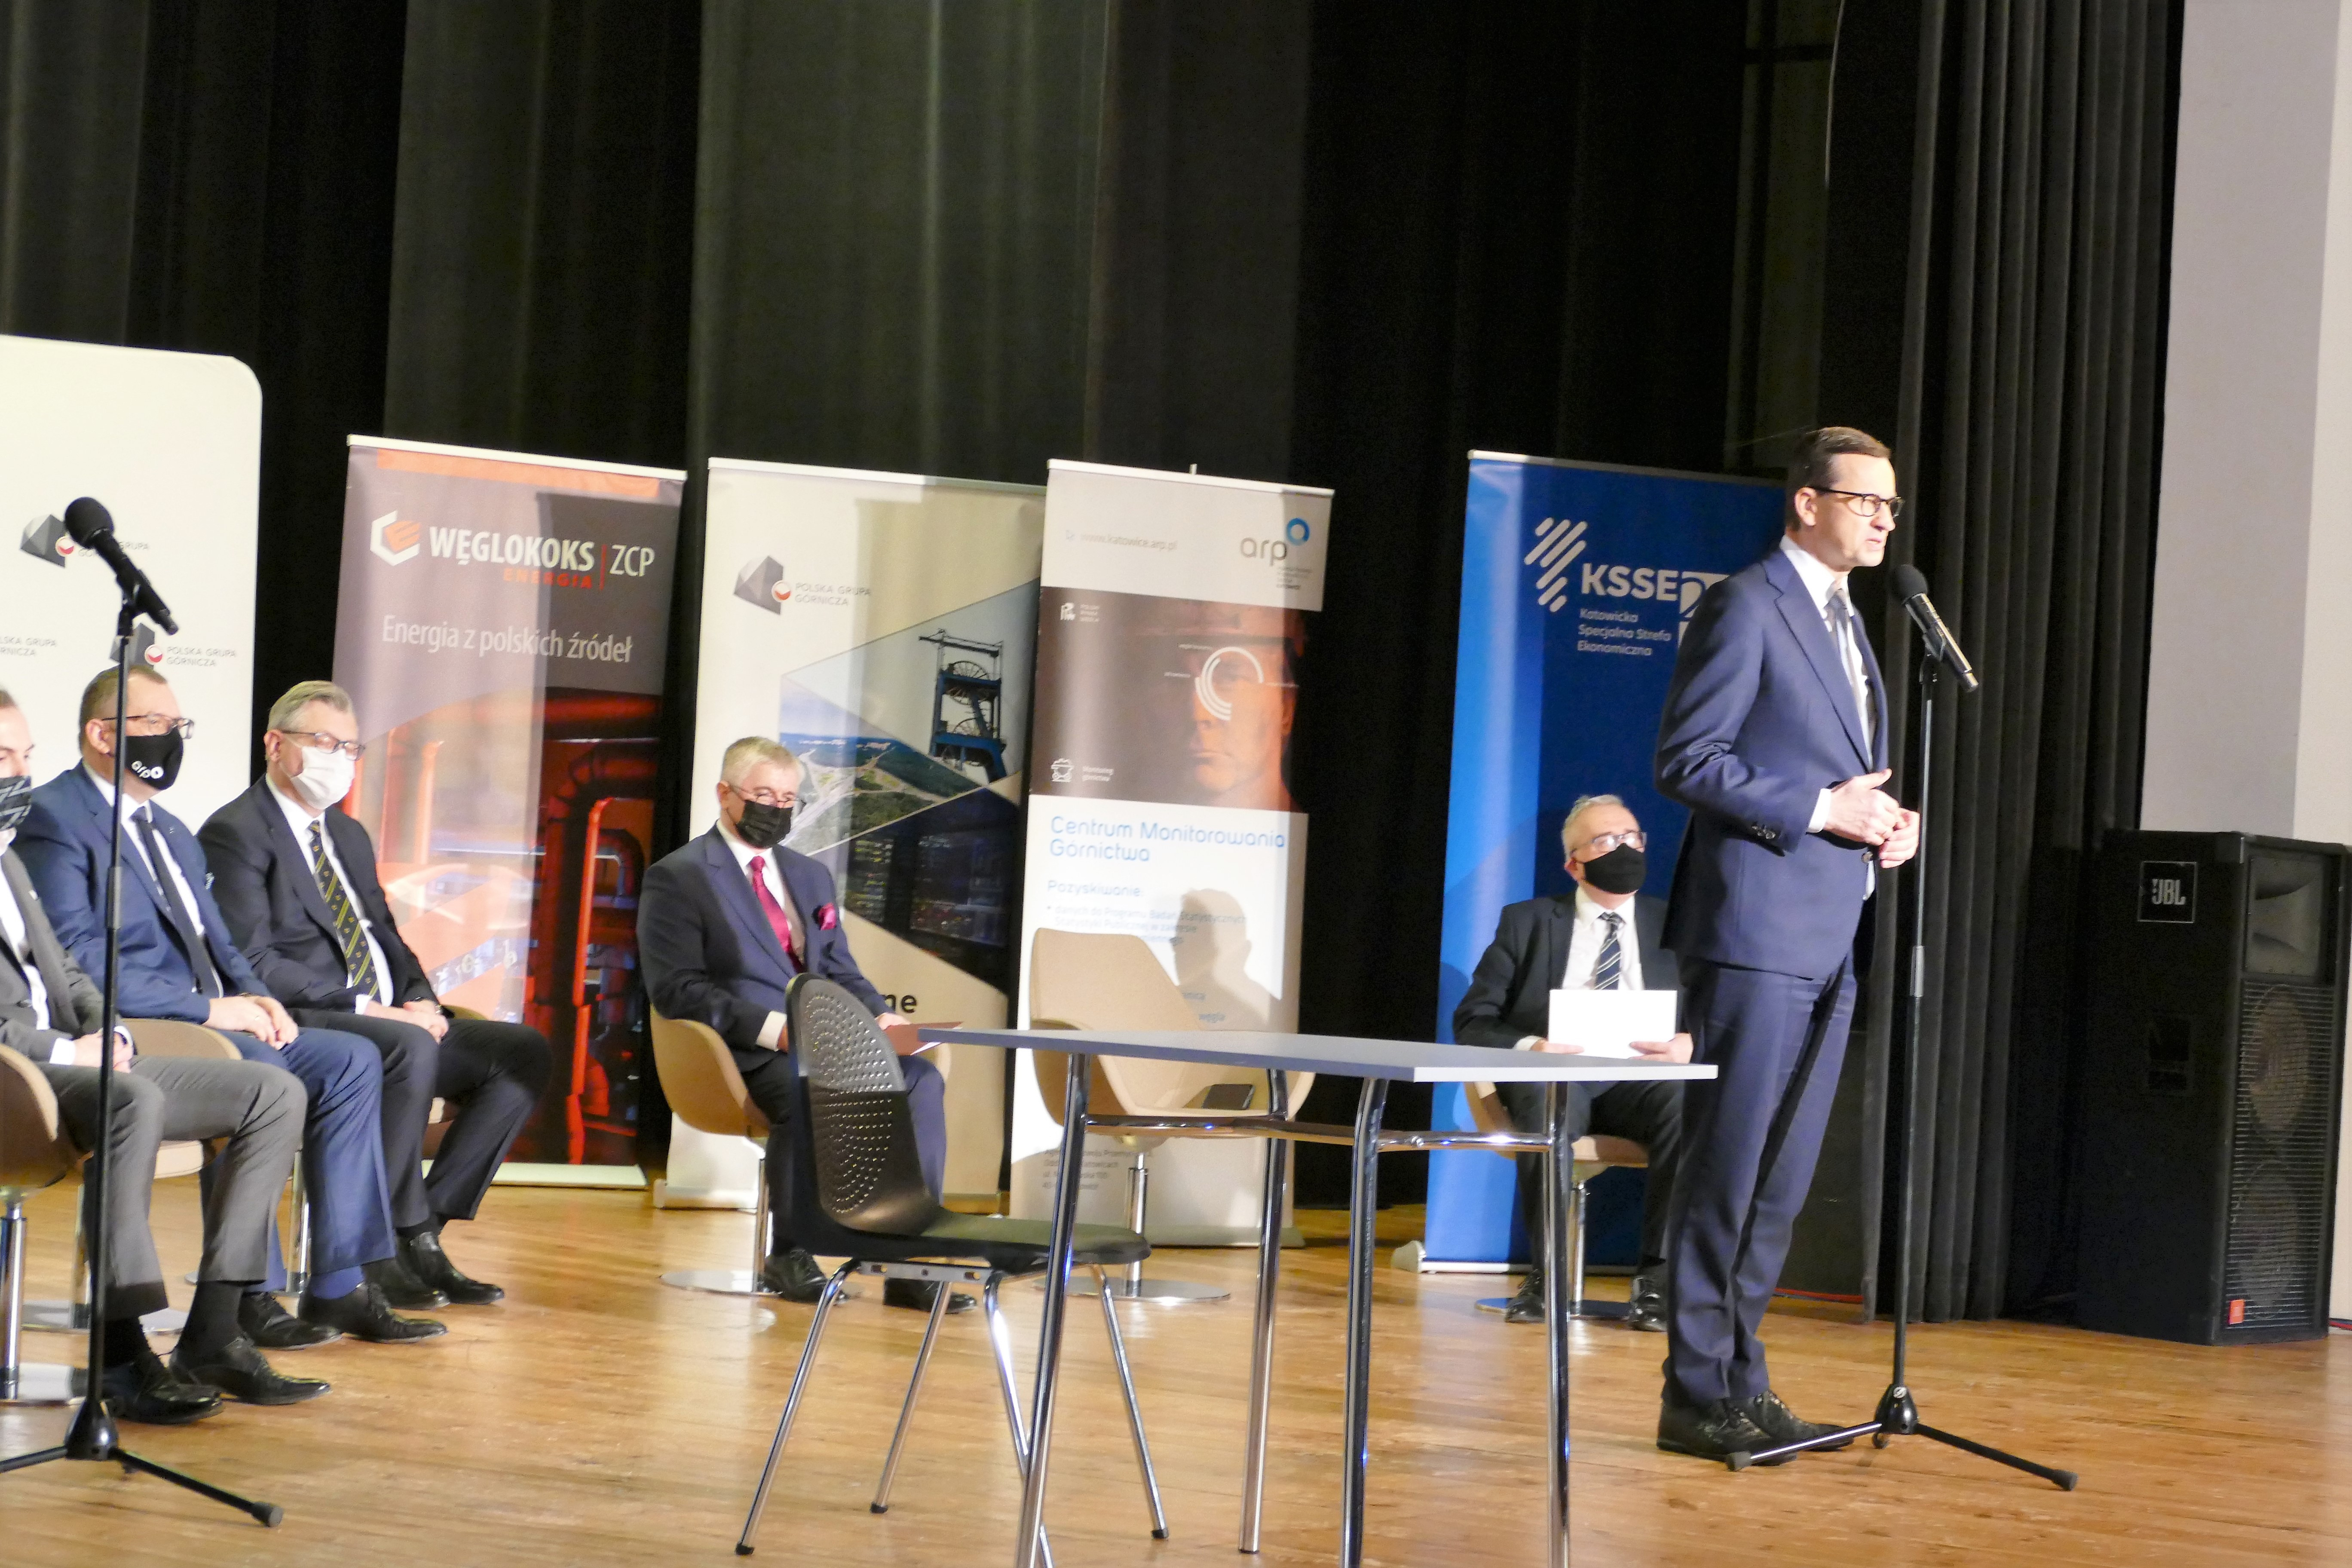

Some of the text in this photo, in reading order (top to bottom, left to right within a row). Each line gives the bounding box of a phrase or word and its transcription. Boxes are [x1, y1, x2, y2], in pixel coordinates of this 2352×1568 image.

[430, 526, 655, 577] WĘGLOKOKS ZCP
[503, 567, 592, 590] ENERGIA
[795, 582, 871, 596] POLSKA GRUPA
[1581, 562, 1678, 601] KSSE
[382, 615, 633, 663] Energia z polskich źródeł
[1578, 625, 1672, 641] Specjalna Strefa
[167, 646, 236, 658] POLSKA GRUPA
[1577, 640, 1653, 656] Ekonomiczna
[1051, 816, 1285, 848] Centrum Monitorowania
[1050, 837, 1151, 862] Górnictwa
[2152, 879, 2186, 905] JBL
